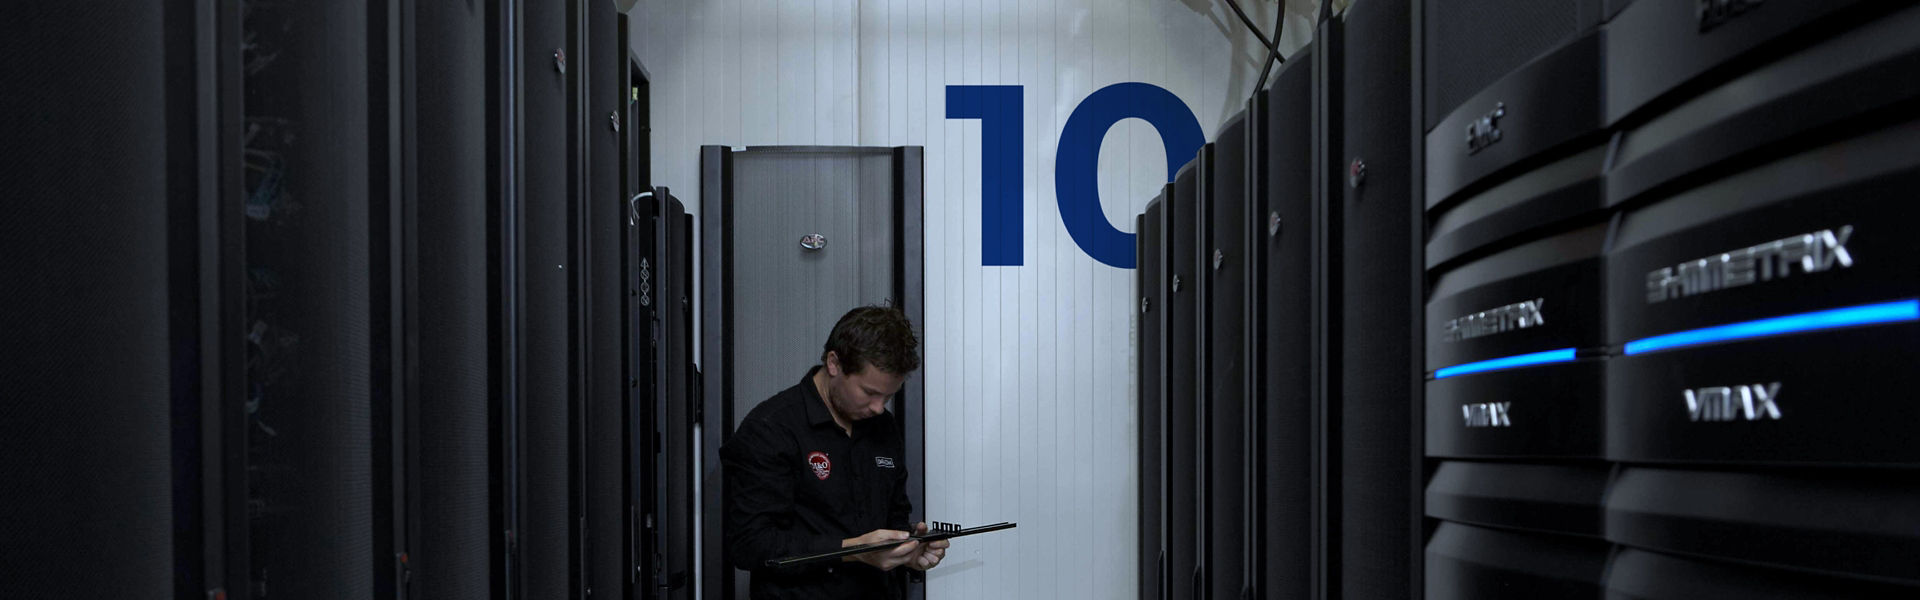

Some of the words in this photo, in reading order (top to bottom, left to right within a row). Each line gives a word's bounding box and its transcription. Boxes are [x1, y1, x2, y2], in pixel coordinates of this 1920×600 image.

[945, 82, 1207, 269] 10
[1461, 400, 1512, 427] VMAX
[1683, 381, 1783, 422] VMAX
